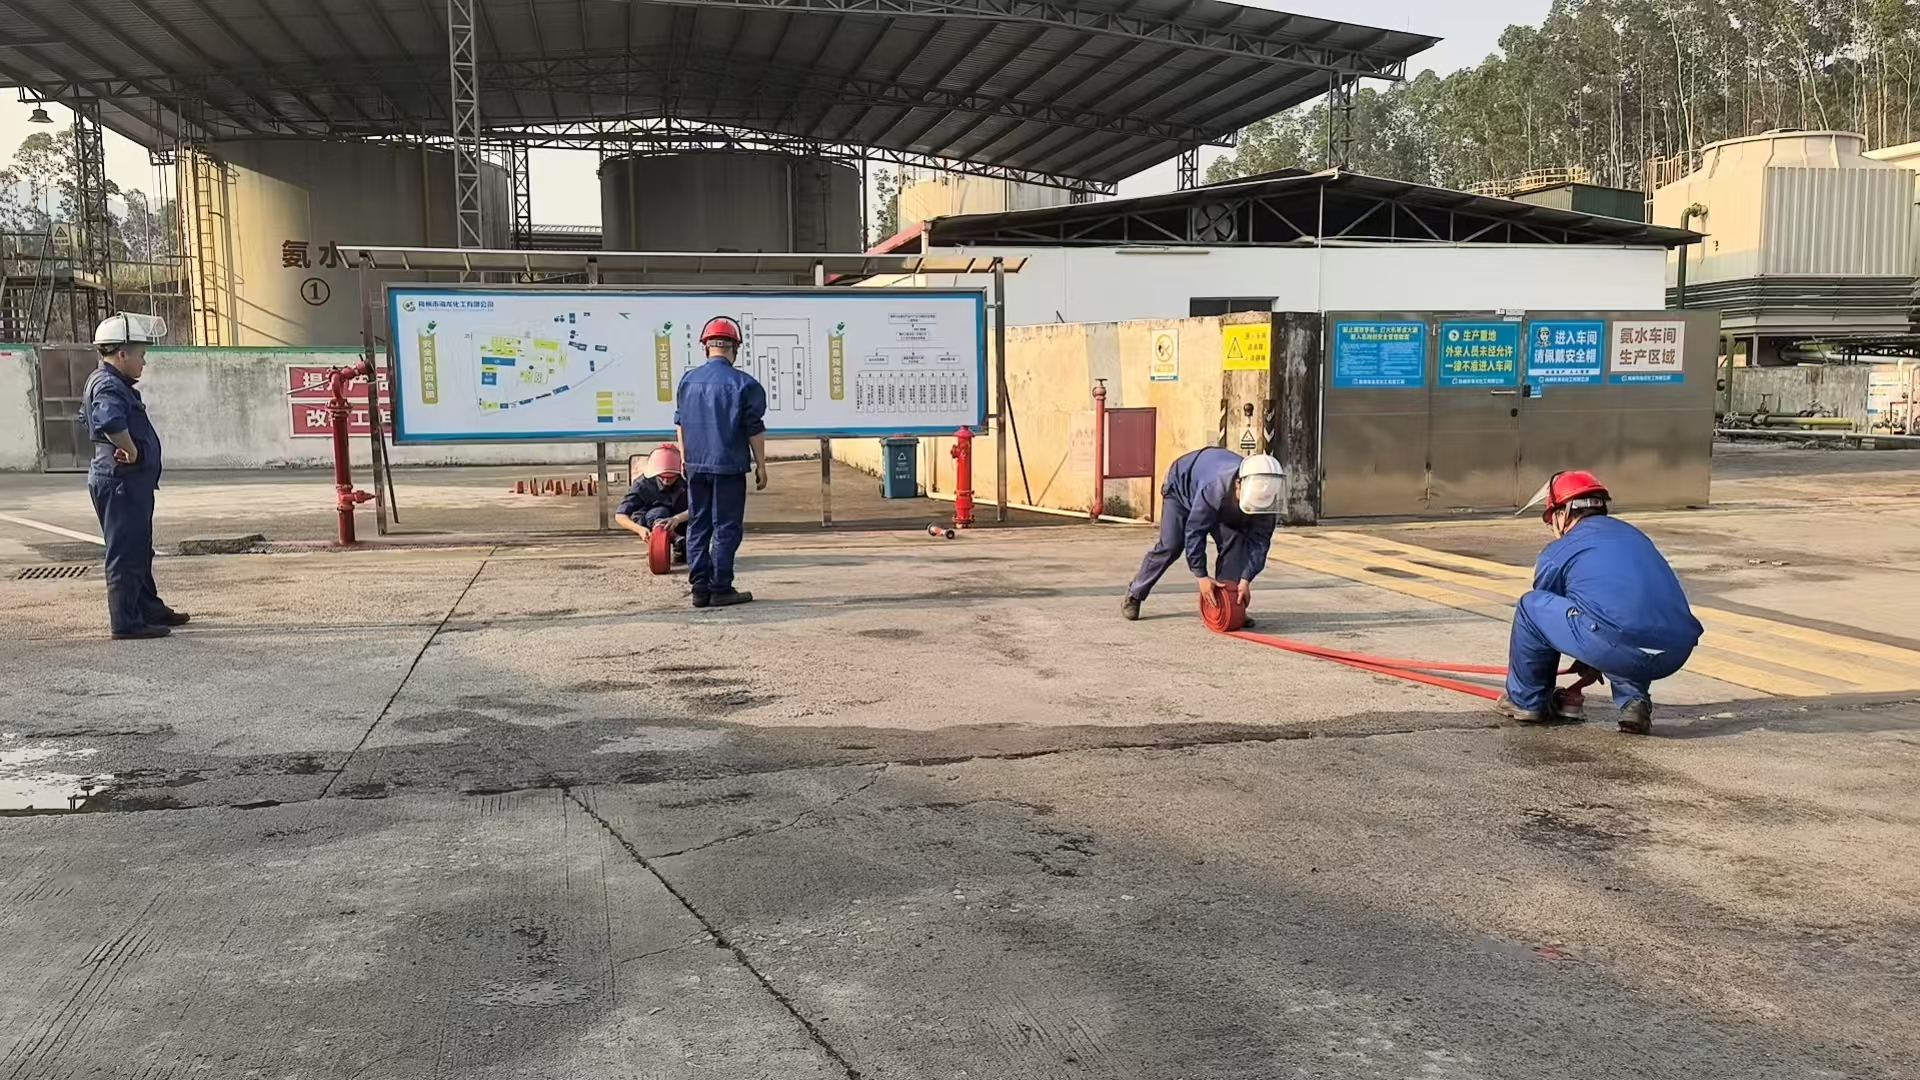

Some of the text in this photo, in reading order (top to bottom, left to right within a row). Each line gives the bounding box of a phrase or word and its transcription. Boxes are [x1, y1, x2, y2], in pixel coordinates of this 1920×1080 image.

[282, 240, 343, 269] 氨水
[1463, 330, 1497, 341] 生产重地
[1555, 330, 1598, 346] 进入车间
[1620, 327, 1677, 344] 氨水车间
[1445, 345, 1513, 358] 外来人员未经允许
[1534, 348, 1597, 364] 请佩戴安全帽
[1620, 348, 1676, 366] 生产区域
[1445, 359, 1513, 372] 一律不准进入车间
[306, 409, 392, 427] 改工作
